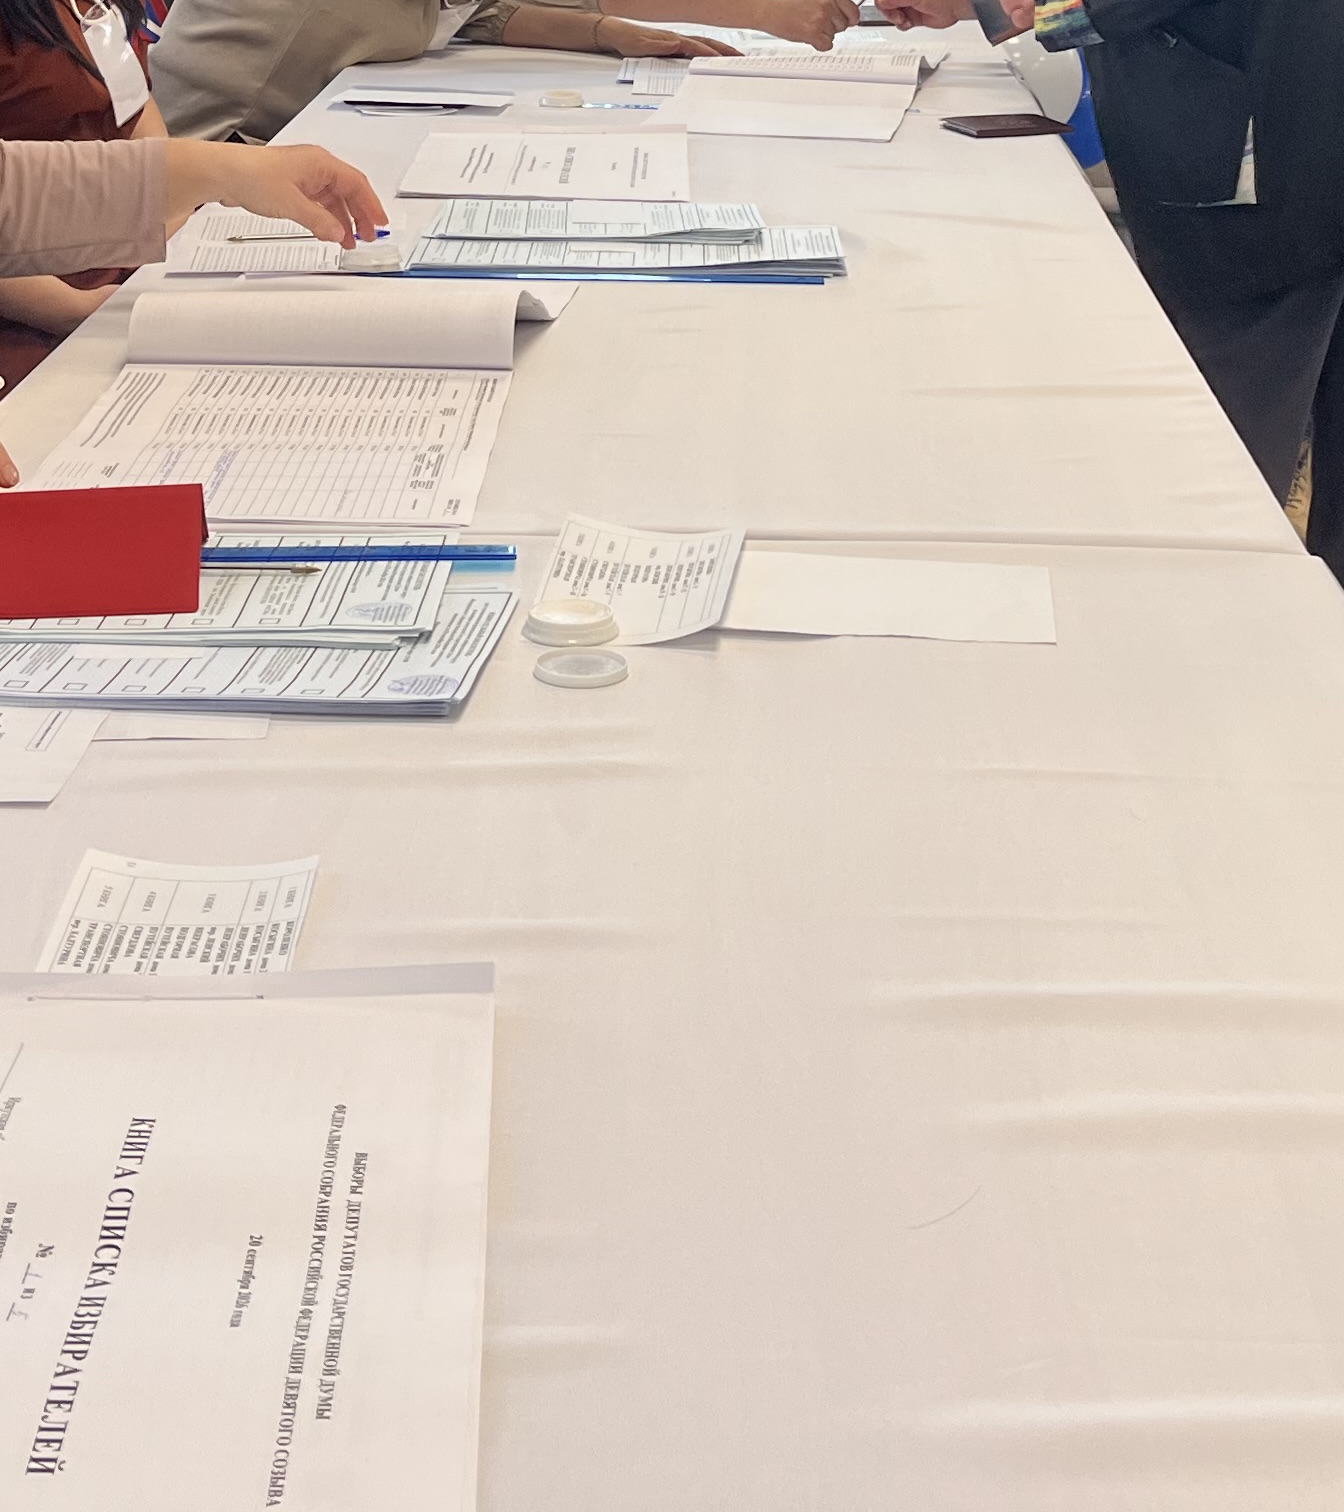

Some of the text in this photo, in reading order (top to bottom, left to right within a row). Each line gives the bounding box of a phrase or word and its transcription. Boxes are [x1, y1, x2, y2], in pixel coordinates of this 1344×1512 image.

[4, 1202, 18, 1214] по
[36, 1243, 54, 1257] №
[248, 1234, 264, 1246] 20
[236, 1248, 256, 1289] сентября
[20, 1288, 36, 1299] из
[26, 1117, 156, 1475] КНИГА СПИСКА ИЗБИРАТЕЛЕЙ
[316, 1151, 368, 1420] ВЫБОРЫ ДЕПУТАТОВ ГОСУДАРСТВЕННОЙ ДУМЫ
[266, 1104, 346, 1507] ФЕДЕРАЛЬНОГО СОБРАНИЯ РОССИЙСКОЙ ФЕДЕРАЦИИ ДЕВЯТОГО СОЗЫВА
